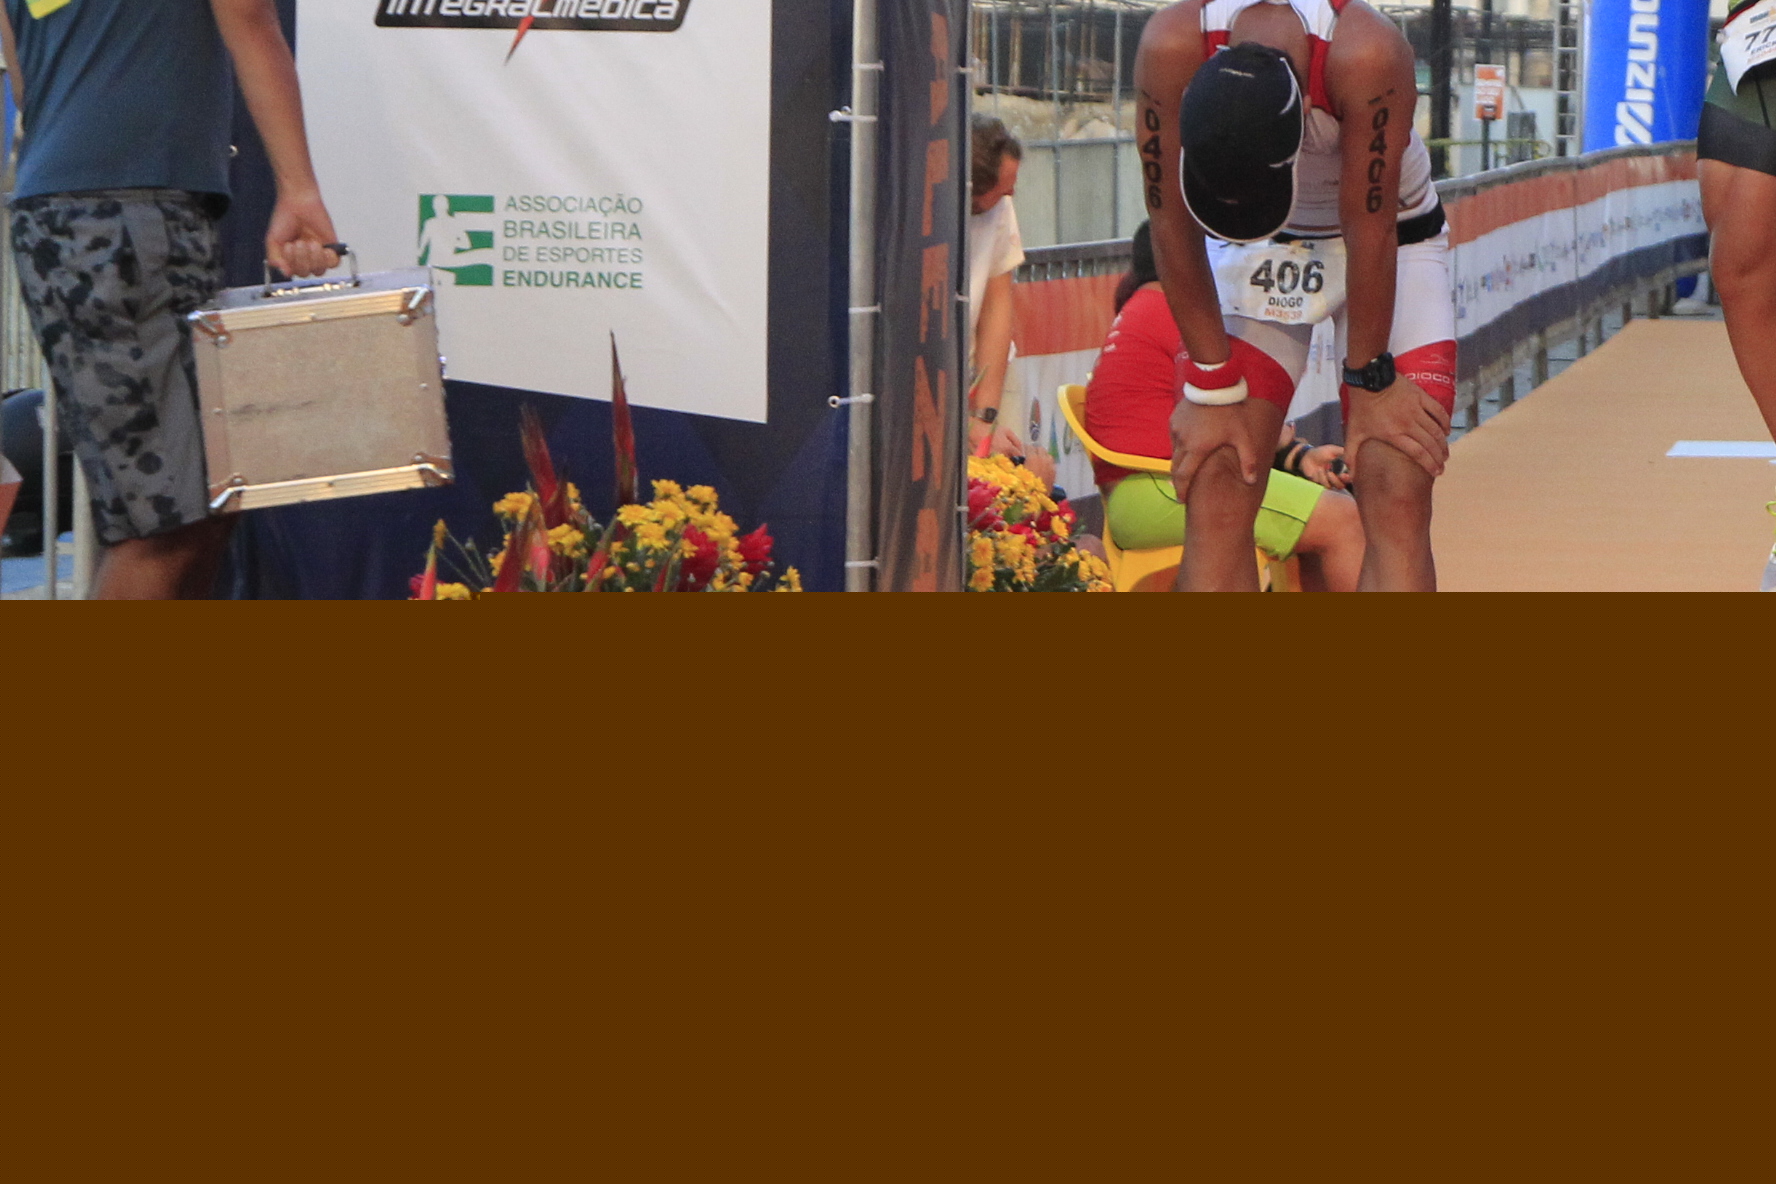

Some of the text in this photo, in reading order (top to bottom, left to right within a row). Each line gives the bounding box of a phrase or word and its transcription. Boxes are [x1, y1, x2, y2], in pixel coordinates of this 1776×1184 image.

[504, 193, 643, 216] ASSOCIAÇÃO
[503, 220, 642, 240] BRASILEIRA
[503, 246, 643, 264] DE ESPORTES
[503, 270, 643, 288] ENDURANCE
[1250, 259, 1325, 294] 406
[1268, 296, 1304, 308] DIOGO
